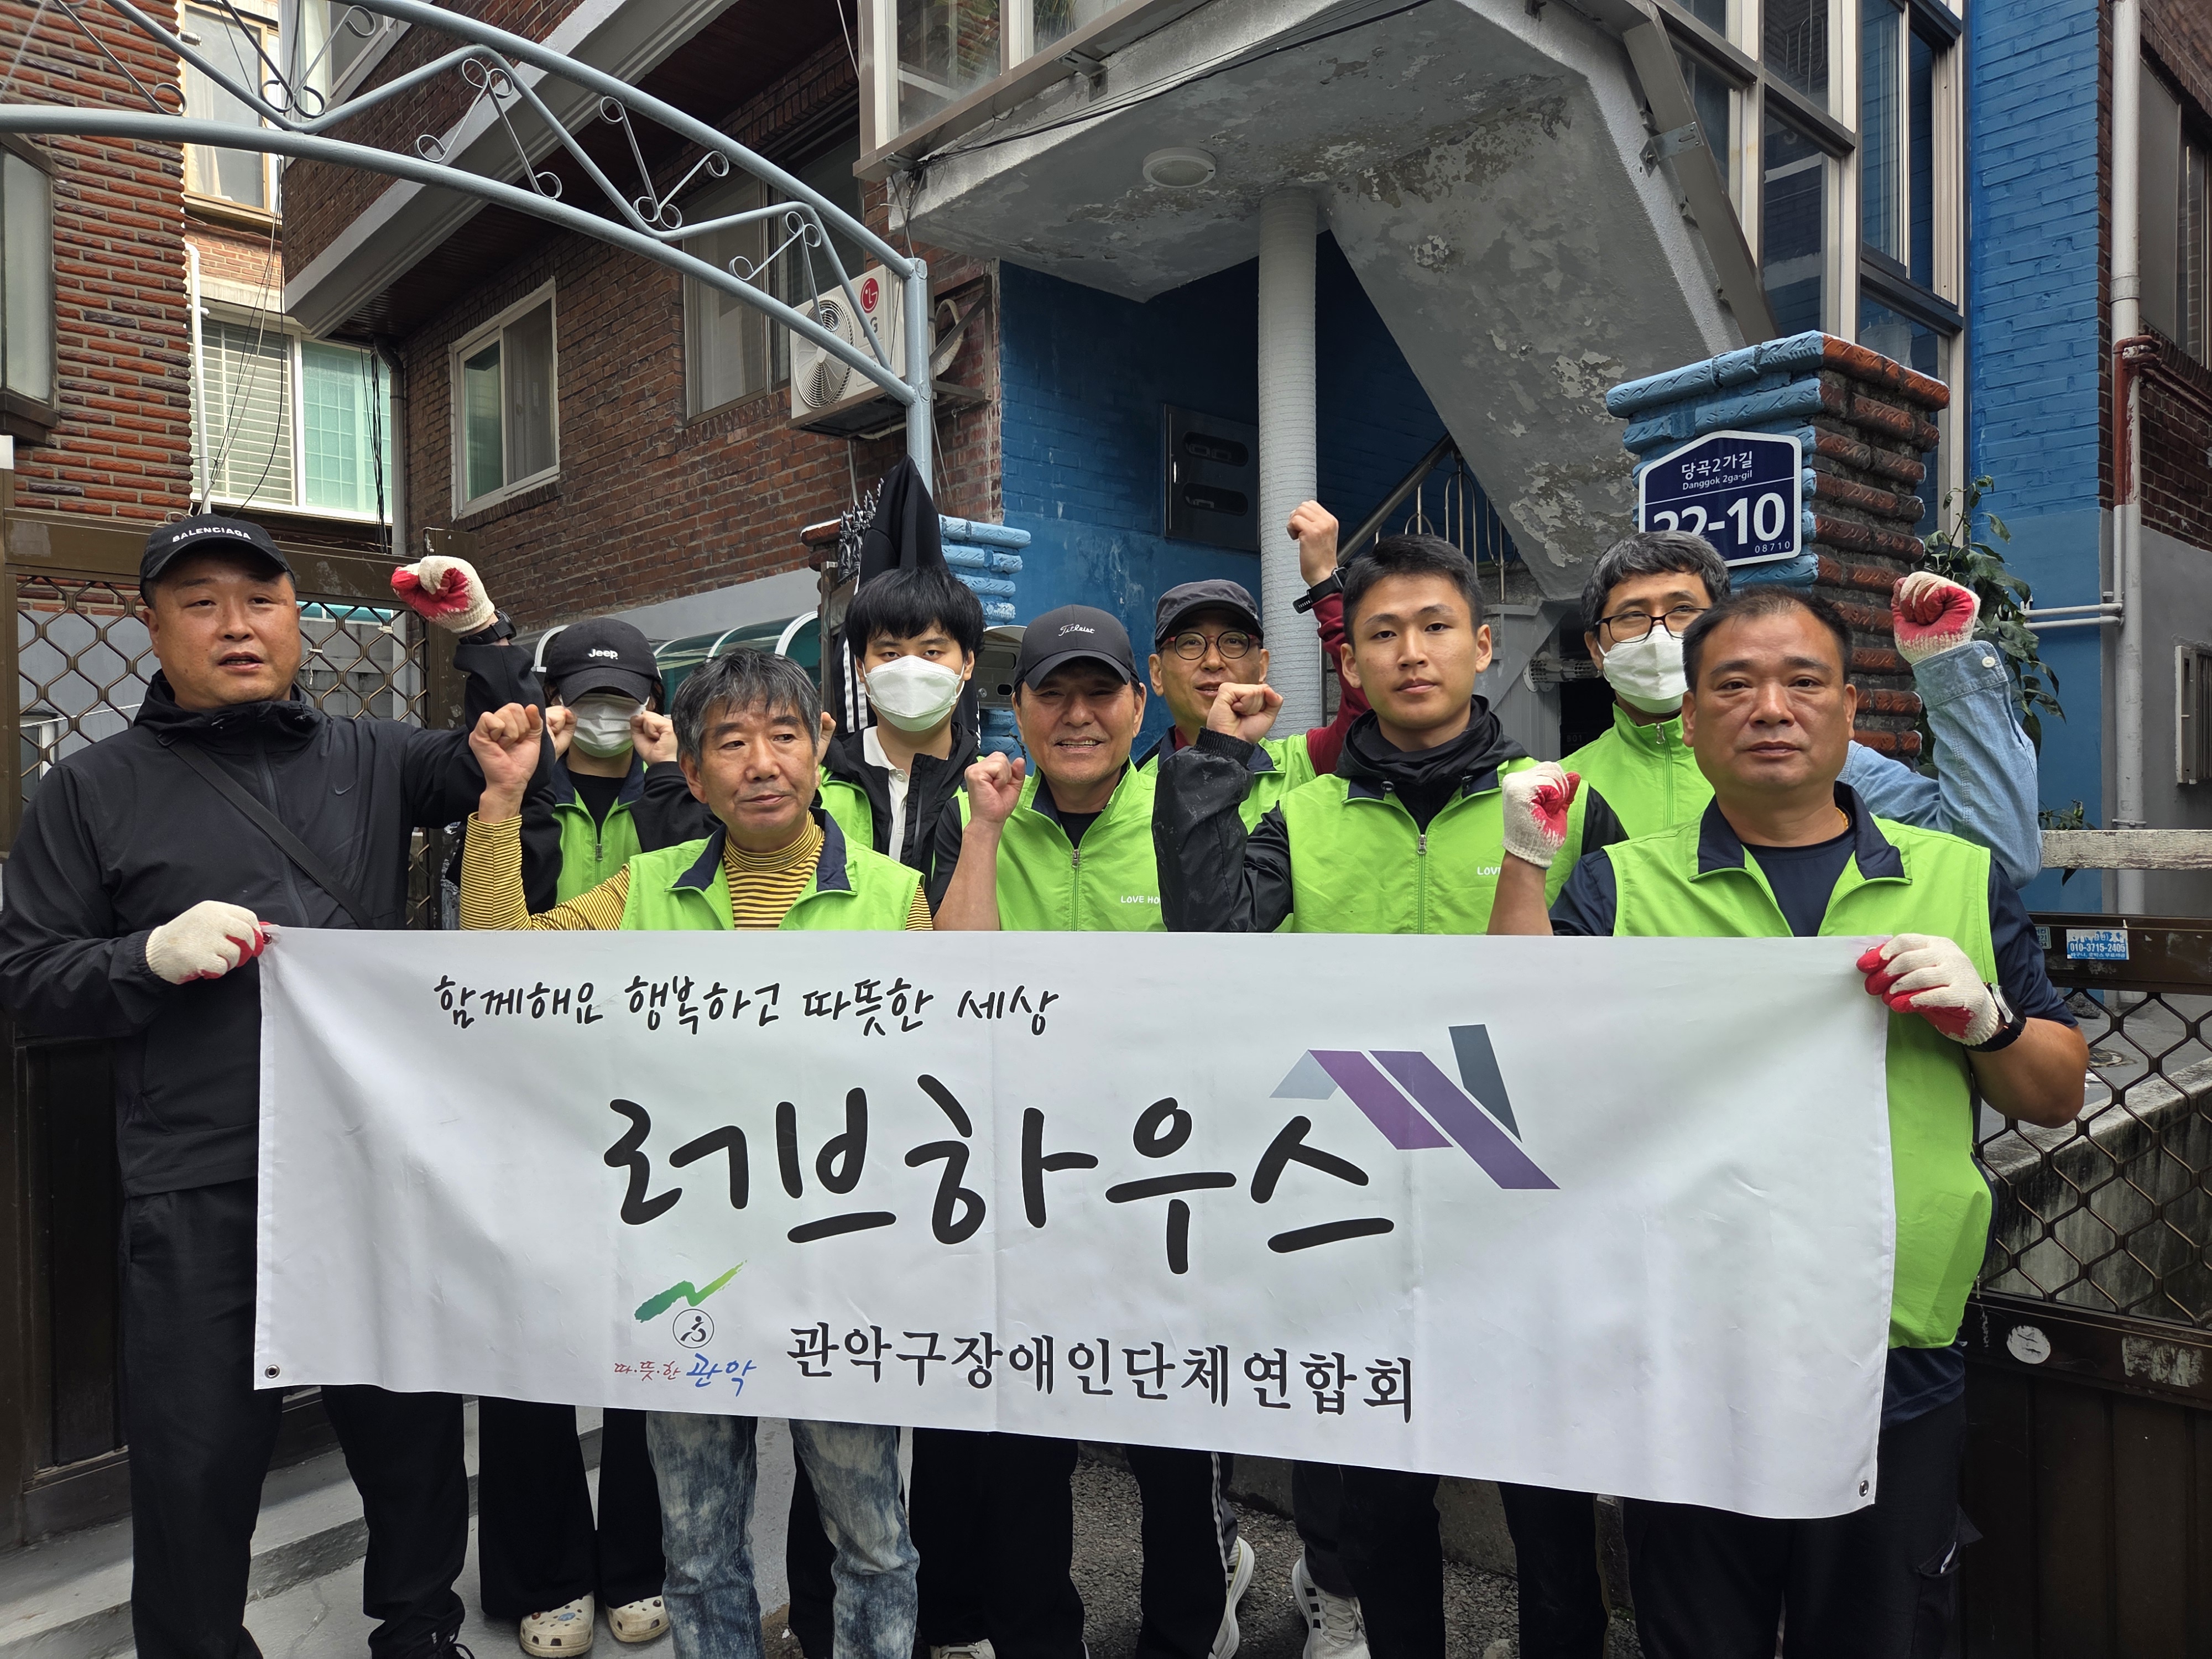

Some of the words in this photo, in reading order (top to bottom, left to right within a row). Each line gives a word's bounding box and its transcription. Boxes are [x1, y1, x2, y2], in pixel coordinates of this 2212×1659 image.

[864, 316, 878, 338] G
[1682, 451, 1752, 481] 당곡2가길
[1683, 476, 1720, 491] Danggok
[1723, 469, 1752, 484] 2ga-gil
[173, 527, 252, 542] BALENCIAGA
[1755, 540, 1791, 554] 08710
[1058, 623, 1095, 637] Titleist
[587, 648, 618, 660] Jeep
[1120, 895, 1145, 904] LOVE
[2070, 943, 2125, 953] 010-3715-2405
[434, 975, 603, 1029] 함께해요
[624, 975, 780, 1035] 행복하고
[802, 977, 934, 1036] 따뜻한
[957, 985, 1059, 1036] 세상
[604, 1074, 1395, 1275] 러브하우스
[686, 1353, 757, 1397] 관악
[786, 1322, 1411, 1423] 관악구장애인단체연합회
